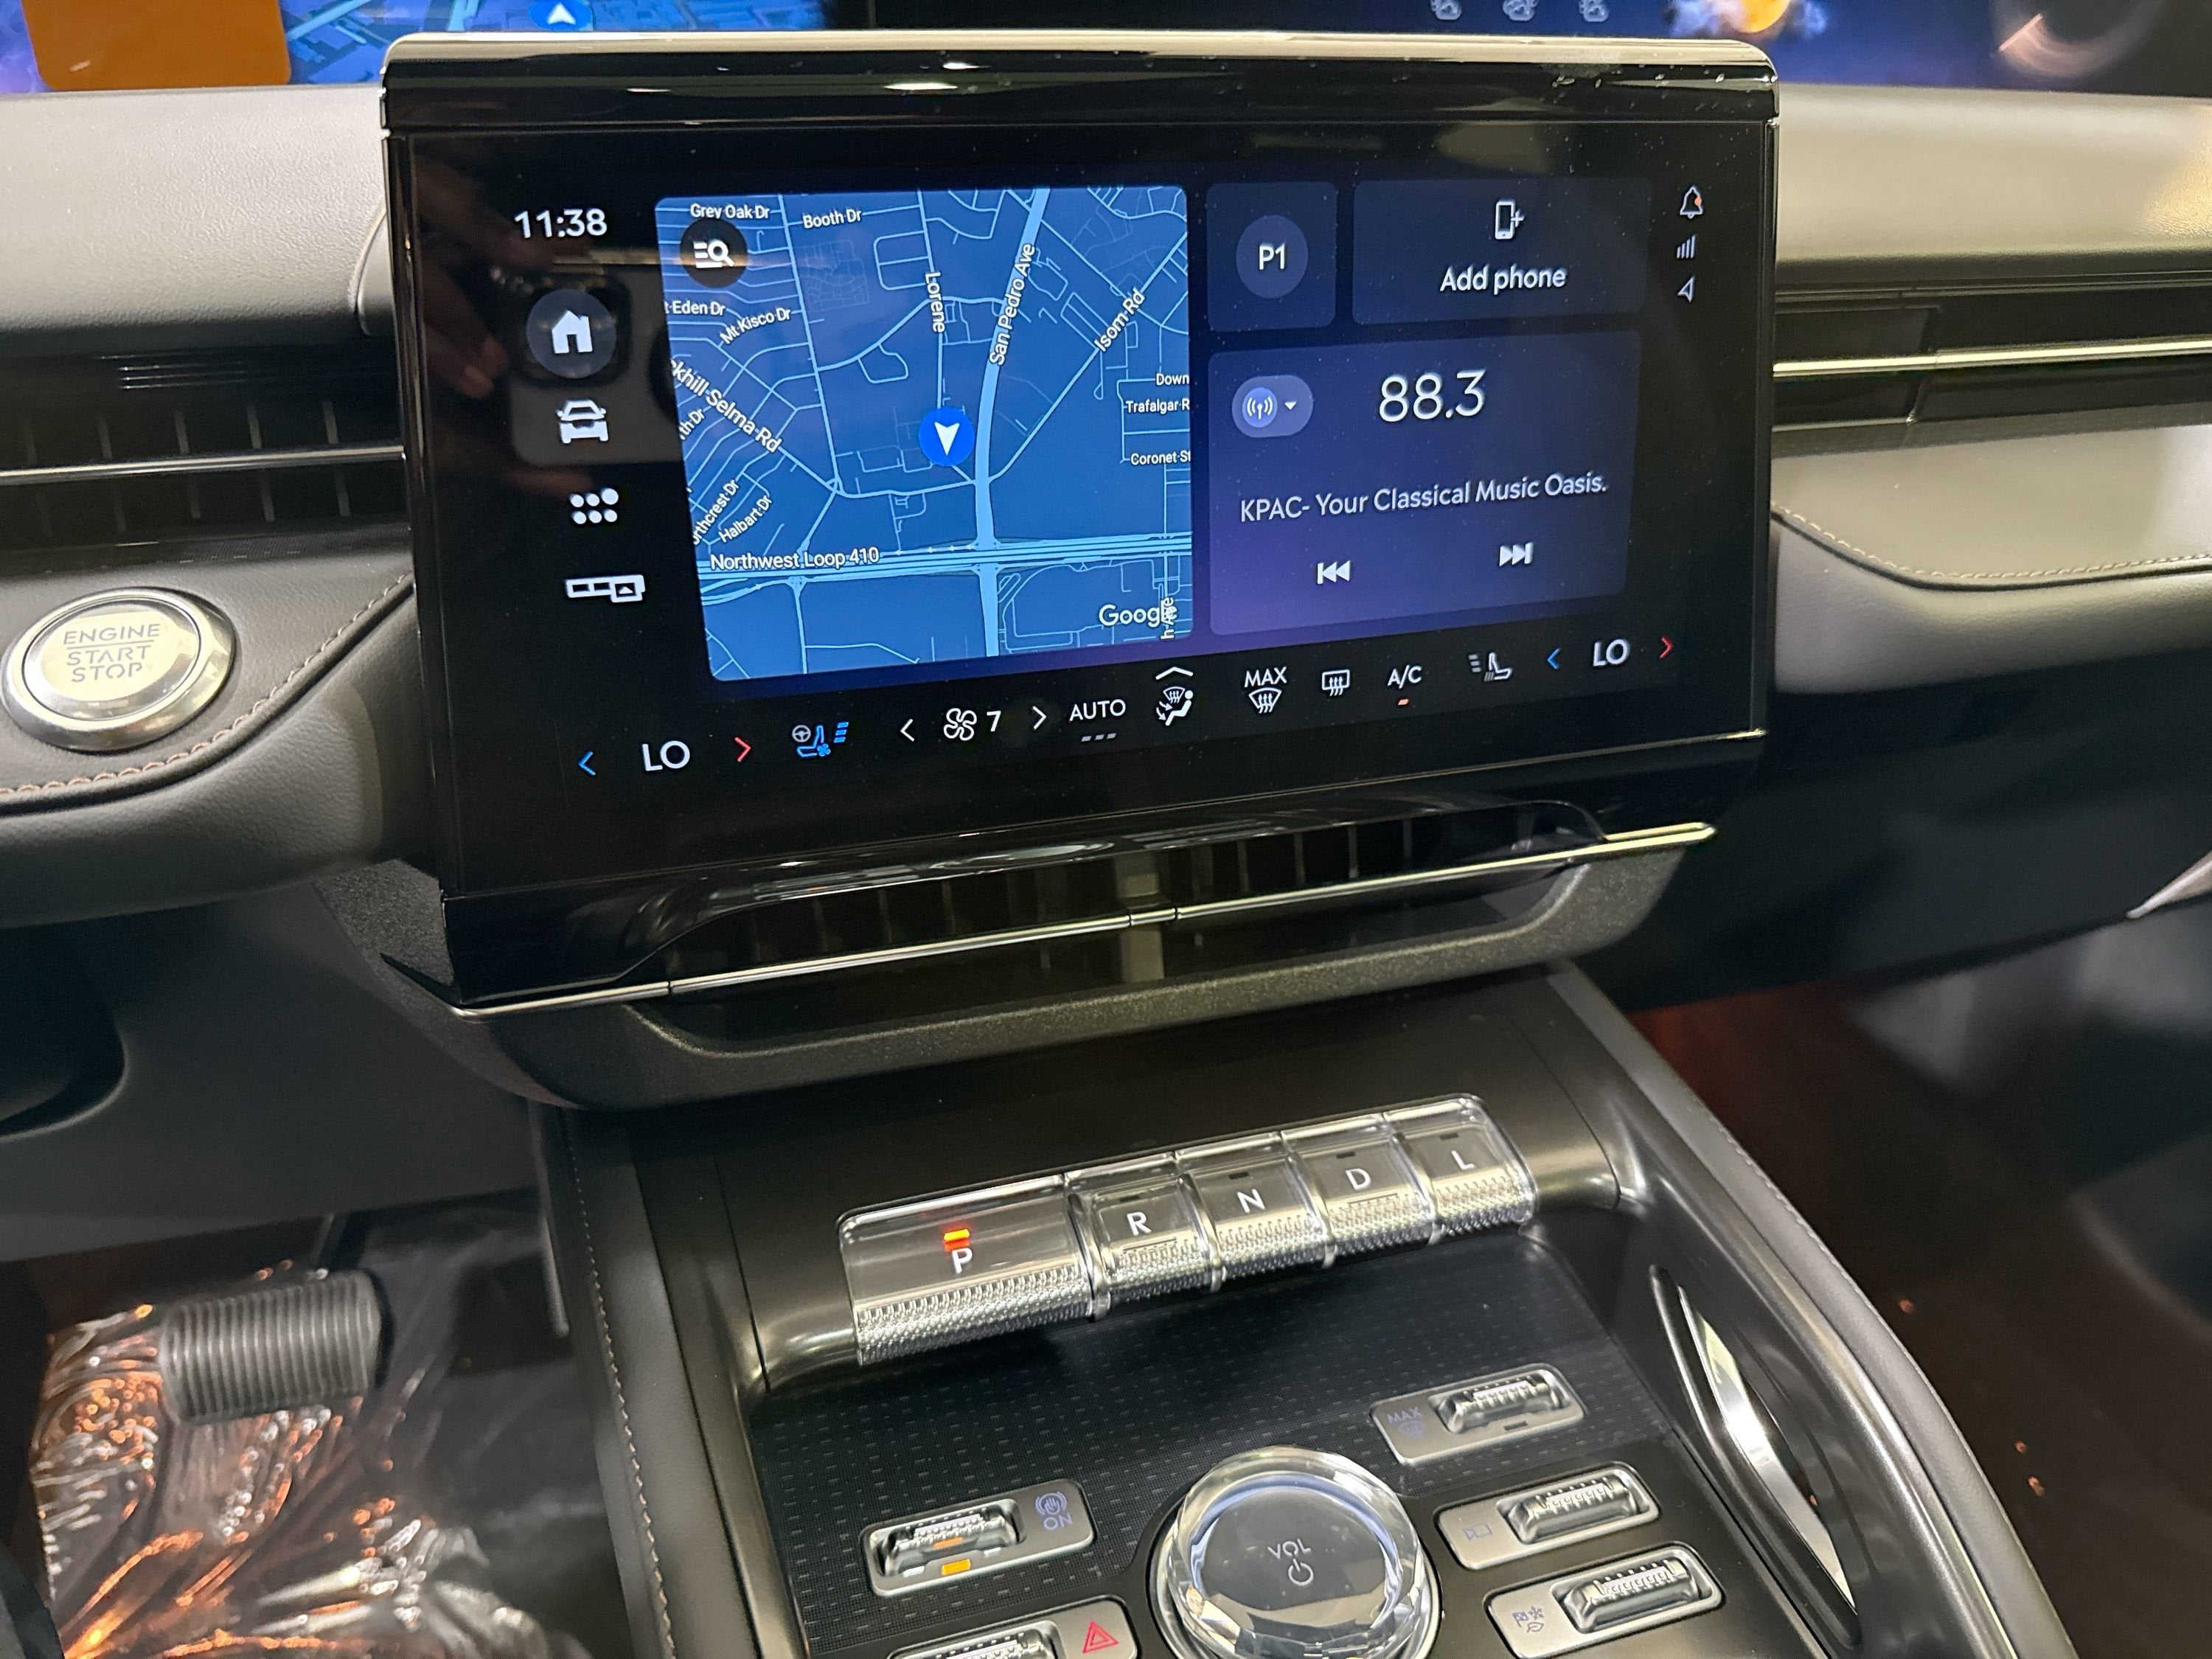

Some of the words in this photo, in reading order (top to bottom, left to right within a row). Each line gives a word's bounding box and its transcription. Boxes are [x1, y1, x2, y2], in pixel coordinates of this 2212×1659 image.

[515, 208, 608, 238] 11:38
[689, 203, 722, 219] Grey
[725, 204, 752, 219] Oak
[754, 205, 771, 219] Dr
[802, 212, 845, 229] Booth
[846, 209, 862, 223] Dr
[1014, 243, 1035, 276] Ave
[1259, 243, 1287, 271] P1
[1439, 266, 1487, 292] Add
[1494, 265, 1567, 296] phone
[672, 299, 708, 315] Eden
[710, 302, 726, 316] Dr
[925, 271, 945, 333] Lorene
[998, 278, 1025, 330] Pedro
[720, 324, 739, 344] Mt
[738, 312, 775, 334] Kisco
[776, 307, 791, 321] Dr
[1094, 316, 1129, 352] Isom
[1123, 288, 1144, 315] Rd
[990, 332, 1011, 366] San
[1155, 372, 1190, 386] Down
[1125, 399, 1179, 415] Trafalgar
[1181, 398, 1190, 411] R
[1379, 369, 1486, 422] 88.3
[688, 408, 706, 425] Dr
[706, 389, 757, 435] Selma
[756, 426, 783, 453] Rd
[1130, 451, 1177, 465] Coronet
[723, 479, 740, 496] Dr
[1239, 494, 1310, 523] KPAC-
[1315, 492, 1368, 516] Your
[1374, 480, 1471, 512] Classical
[1475, 474, 1540, 503] Music
[1544, 470, 1607, 497] Oasis.
[718, 508, 763, 543] Halbart
[756, 495, 773, 511] Dr
[710, 553, 799, 571] Northwest
[804, 550, 846, 569] Loop
[849, 547, 880, 564] 410
[63, 623, 161, 645] ENGINE
[66, 644, 152, 667] START
[1593, 639, 1630, 667] LO
[72, 661, 144, 683] STOP
[1244, 667, 1287, 689] MAX
[1387, 665, 1422, 689] A/C
[986, 710, 1002, 732] 7
[1069, 698, 1127, 722] AUTO
[641, 740, 691, 772] LO
[1450, 1148, 1475, 1171] L
[1346, 1167, 1372, 1191] D
[1237, 1188, 1263, 1214] N
[1128, 1211, 1149, 1237] R
[952, 1247, 974, 1274] P
[1387, 1406, 1423, 1425] MAX
[1043, 1512, 1073, 1532] ON
[1267, 1538, 1312, 1559] VOL
